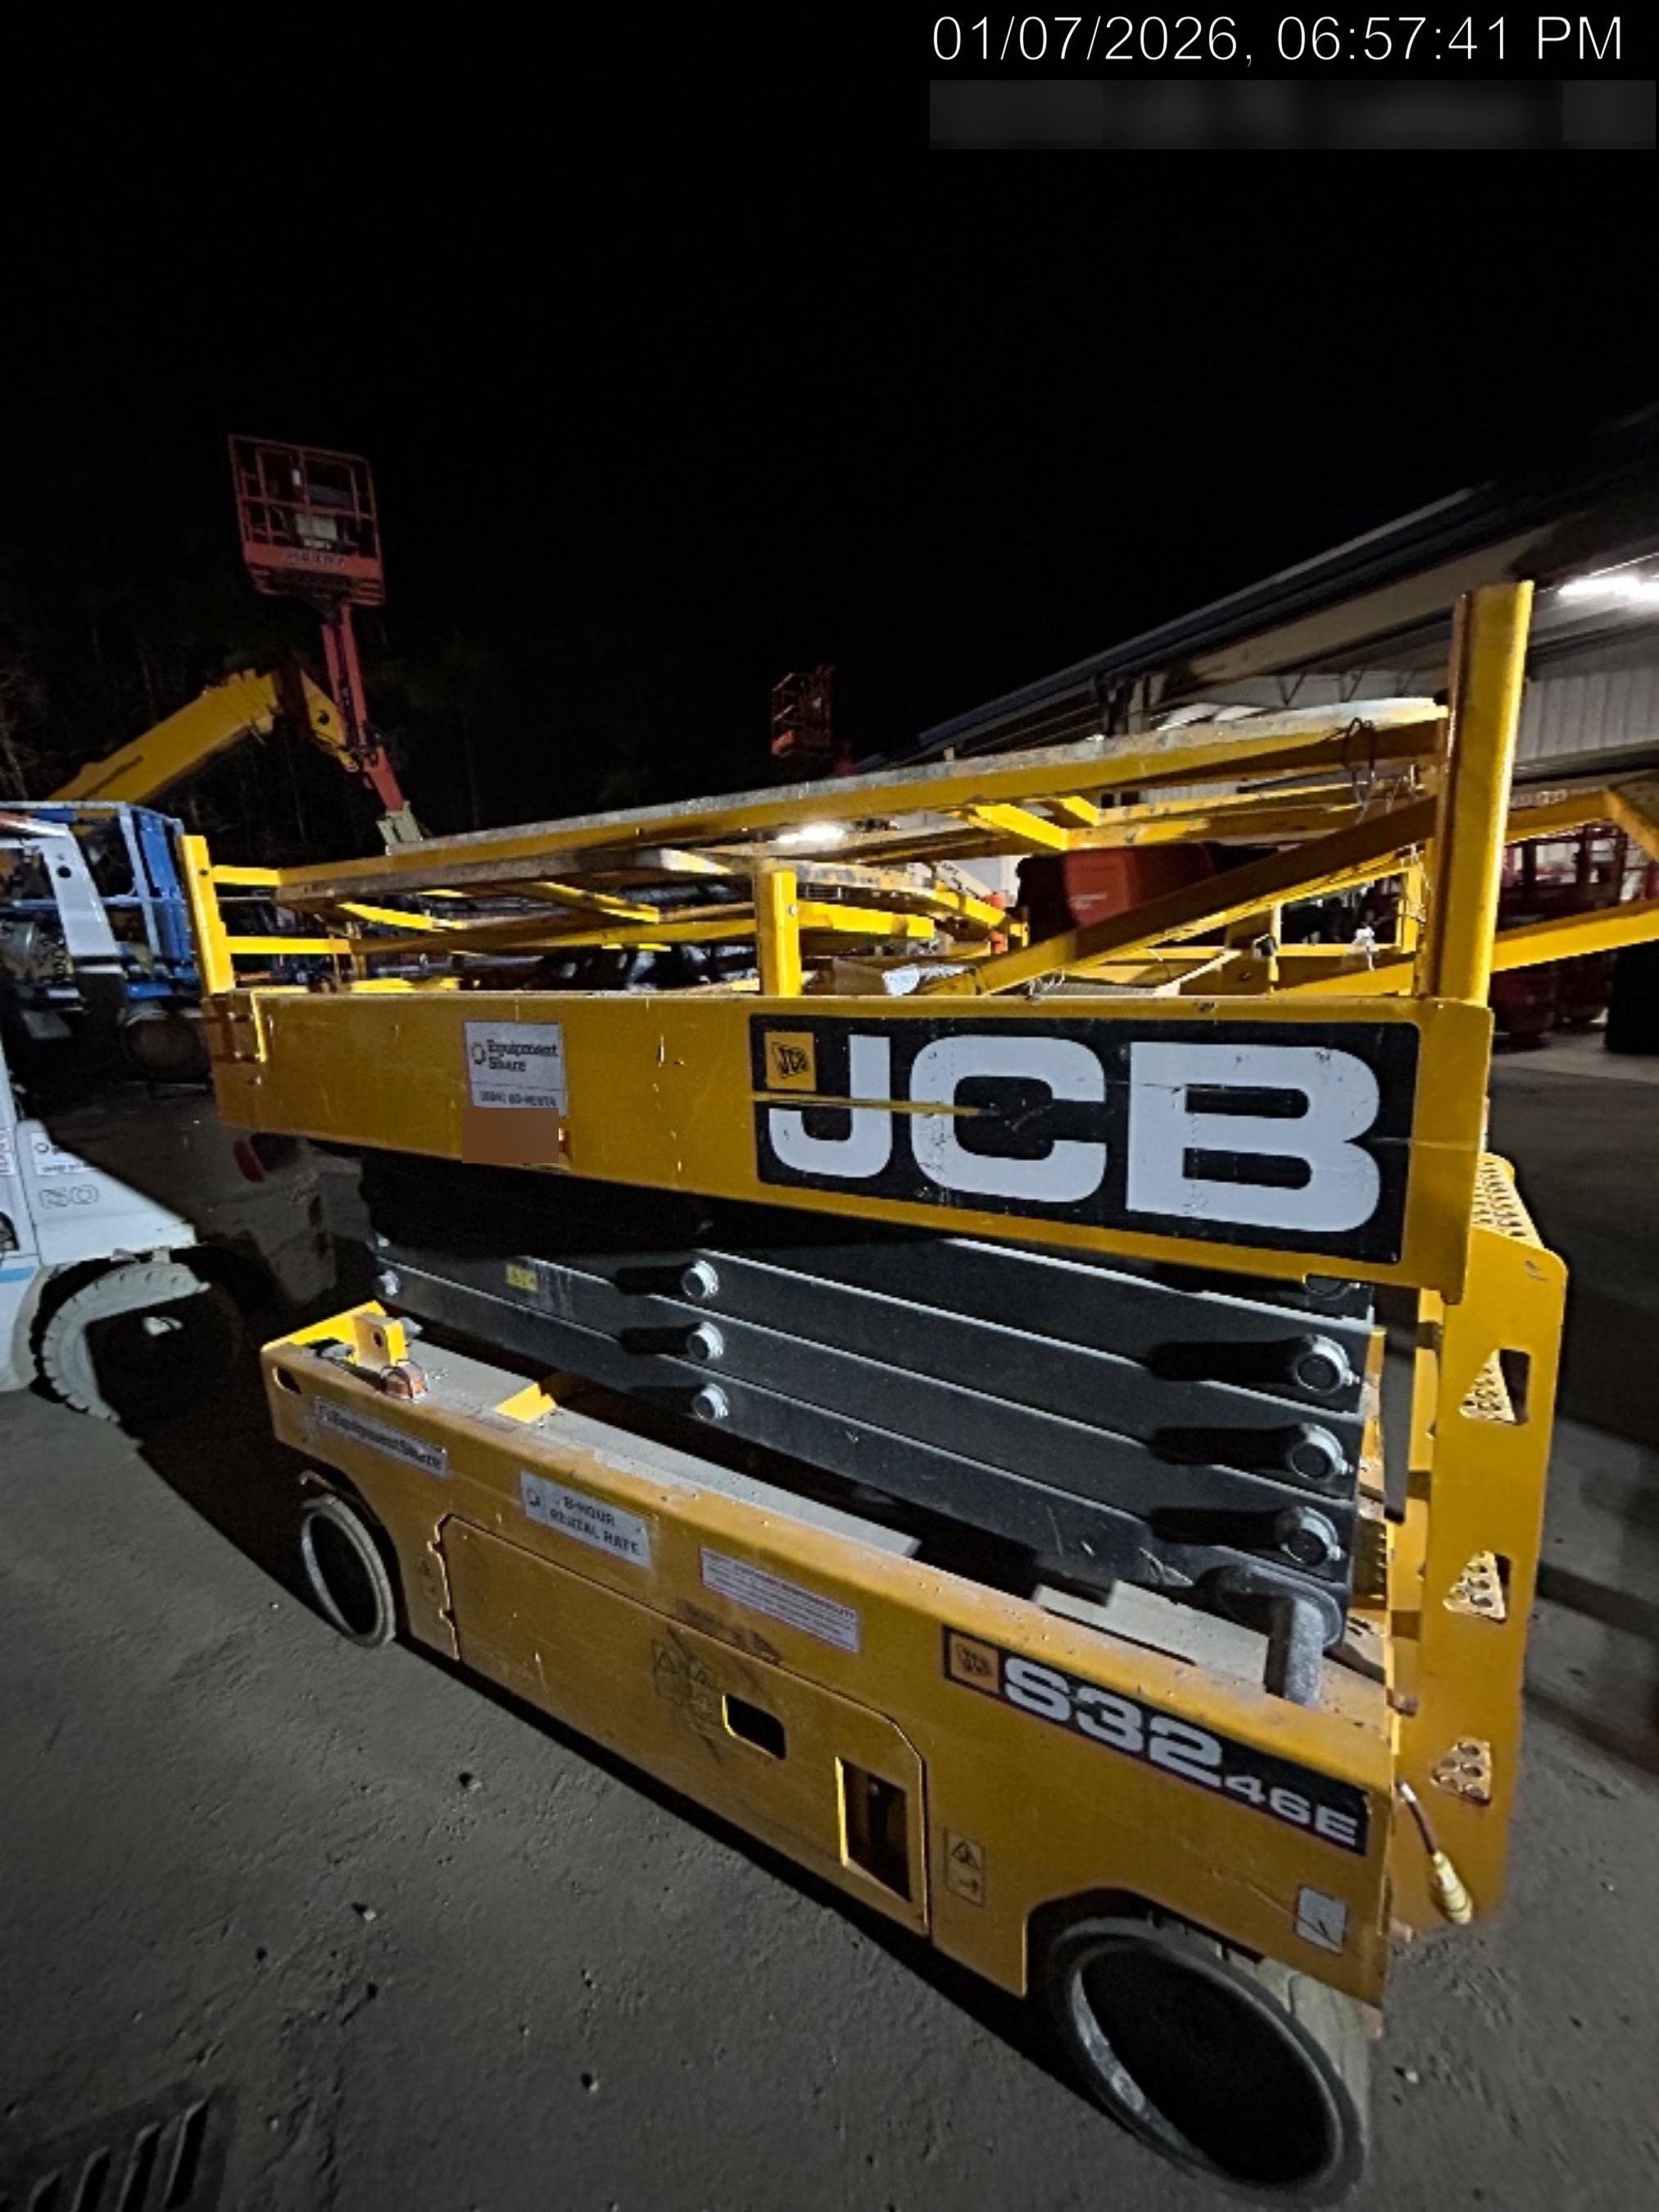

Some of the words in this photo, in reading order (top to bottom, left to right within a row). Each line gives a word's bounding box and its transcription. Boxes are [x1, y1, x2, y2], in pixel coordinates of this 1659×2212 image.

[487, 1039, 558, 1058] Equipment
[488, 1056, 527, 1072] Share
[769, 1034, 1380, 1232] JCB
[603, 1530, 641, 1557] RATE
